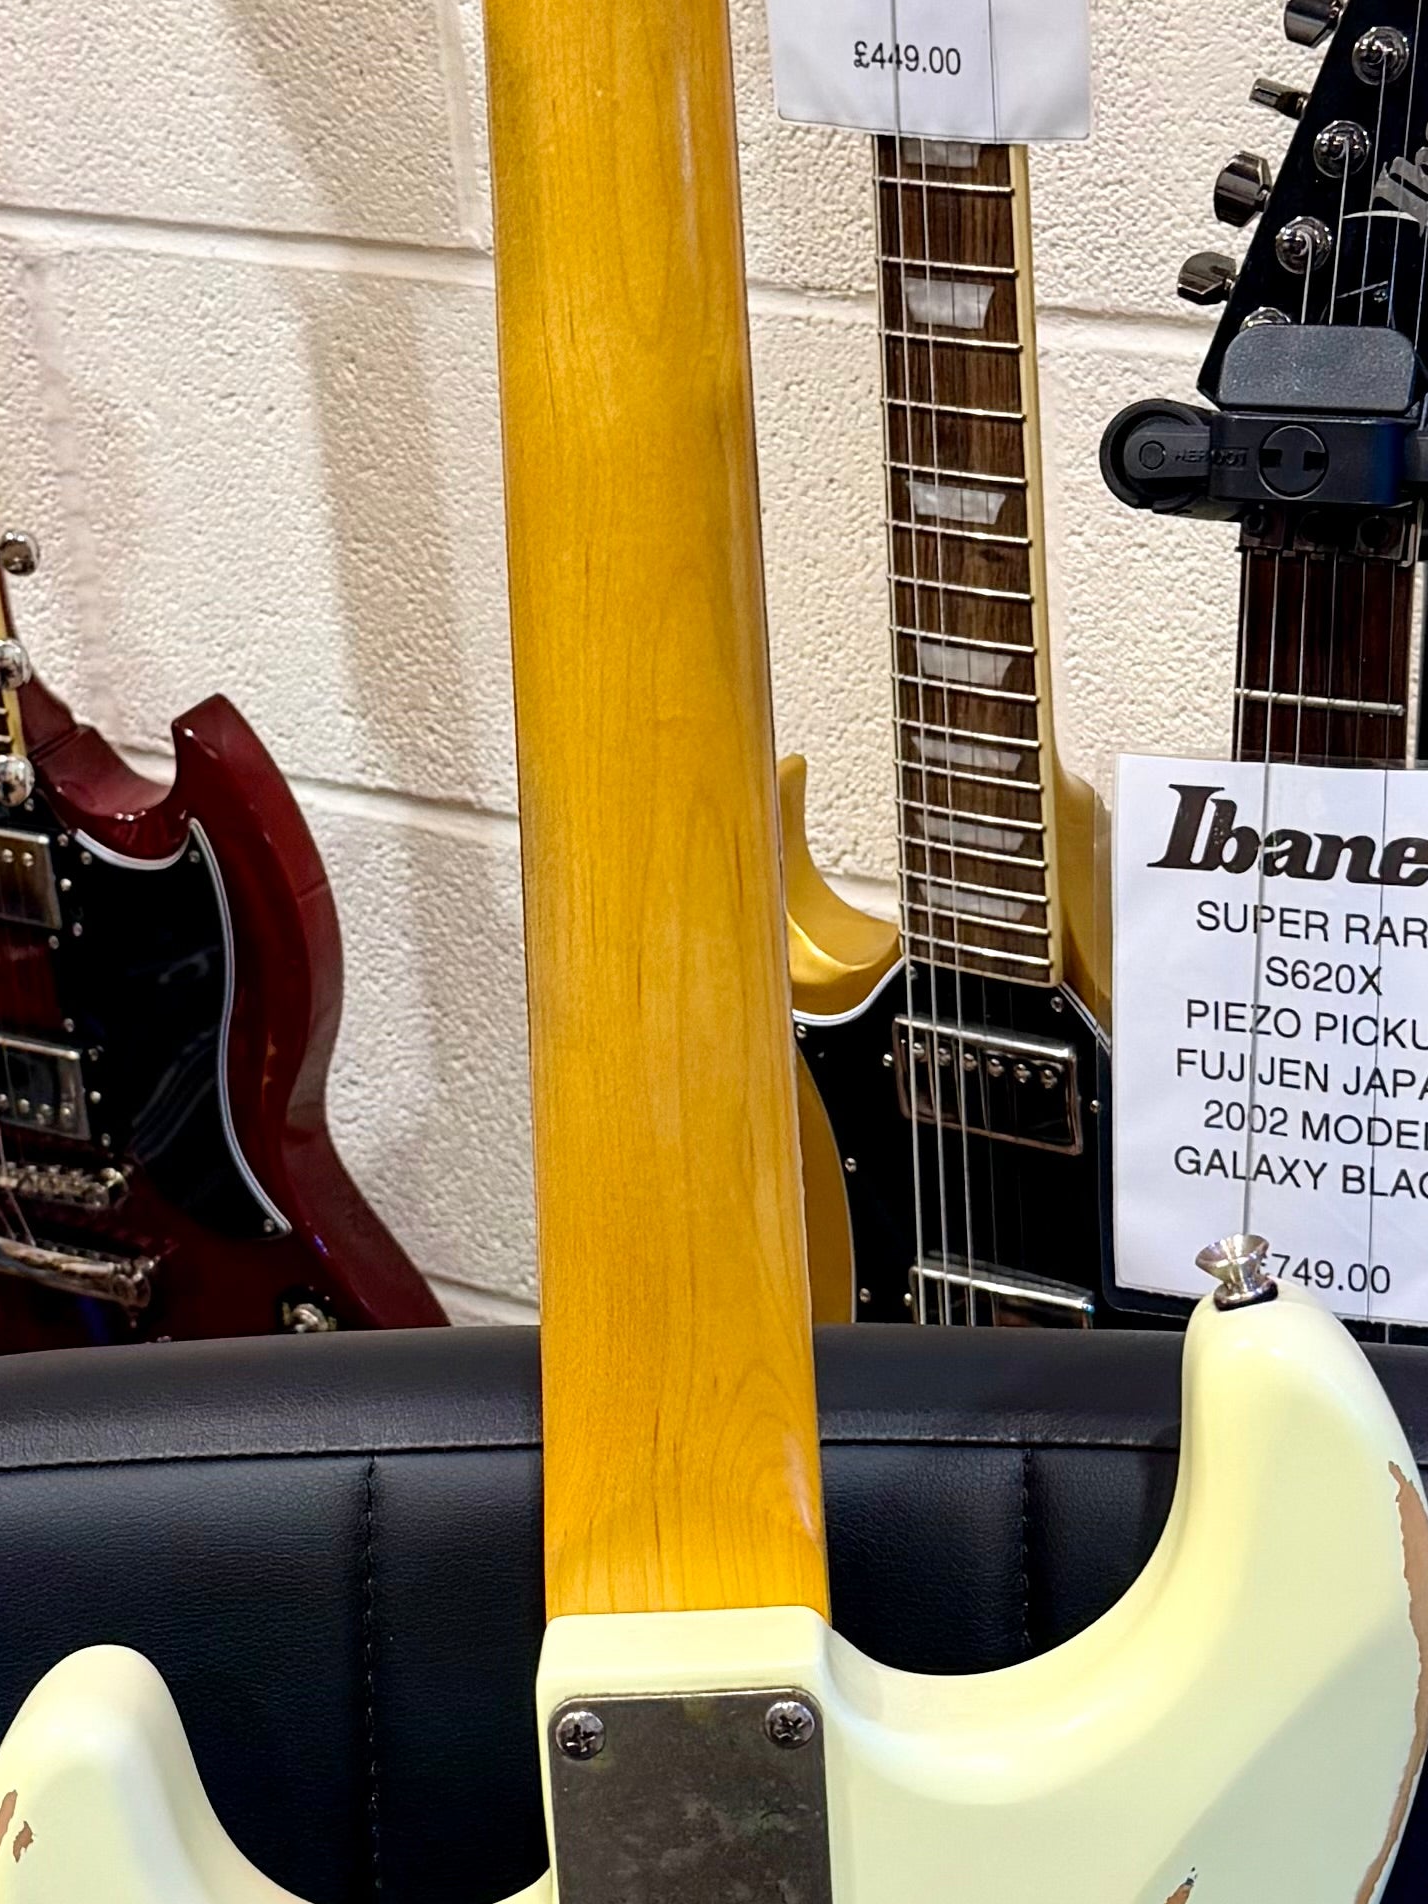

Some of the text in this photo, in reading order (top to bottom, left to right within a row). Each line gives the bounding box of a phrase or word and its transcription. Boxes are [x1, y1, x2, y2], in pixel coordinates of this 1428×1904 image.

[853, 41, 962, 76] £449.00
[1196, 901, 1330, 943] SUPER
[1265, 957, 1383, 997] S620X
[1186, 999, 1302, 1038] PIEZO
[1204, 1100, 1289, 1137] 2002
[1173, 1146, 1328, 1190] GALAXY
